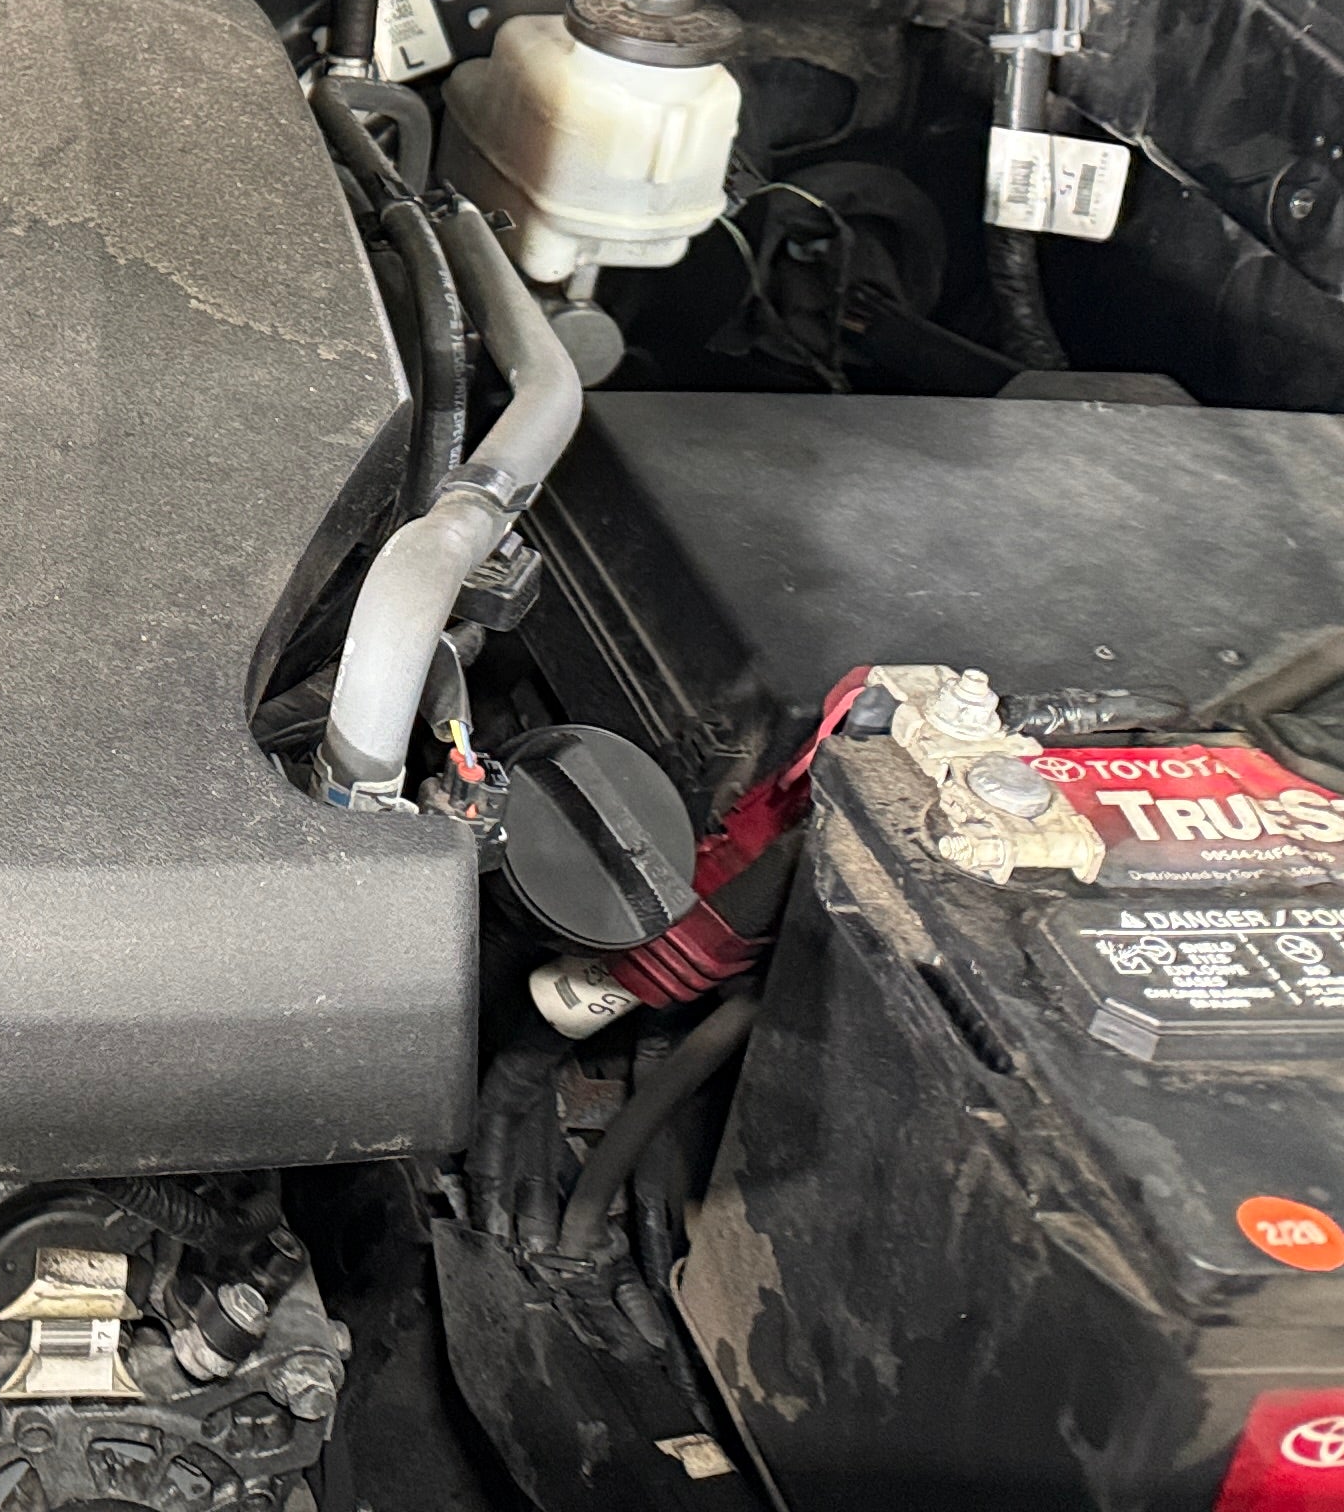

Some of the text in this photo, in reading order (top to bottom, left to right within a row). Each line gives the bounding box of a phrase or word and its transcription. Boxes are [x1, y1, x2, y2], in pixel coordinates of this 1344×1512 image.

[1085, 755, 1243, 780] TOYOTA
[1095, 789, 1344, 843] TRUES
[1144, 909, 1272, 930] DANGER
